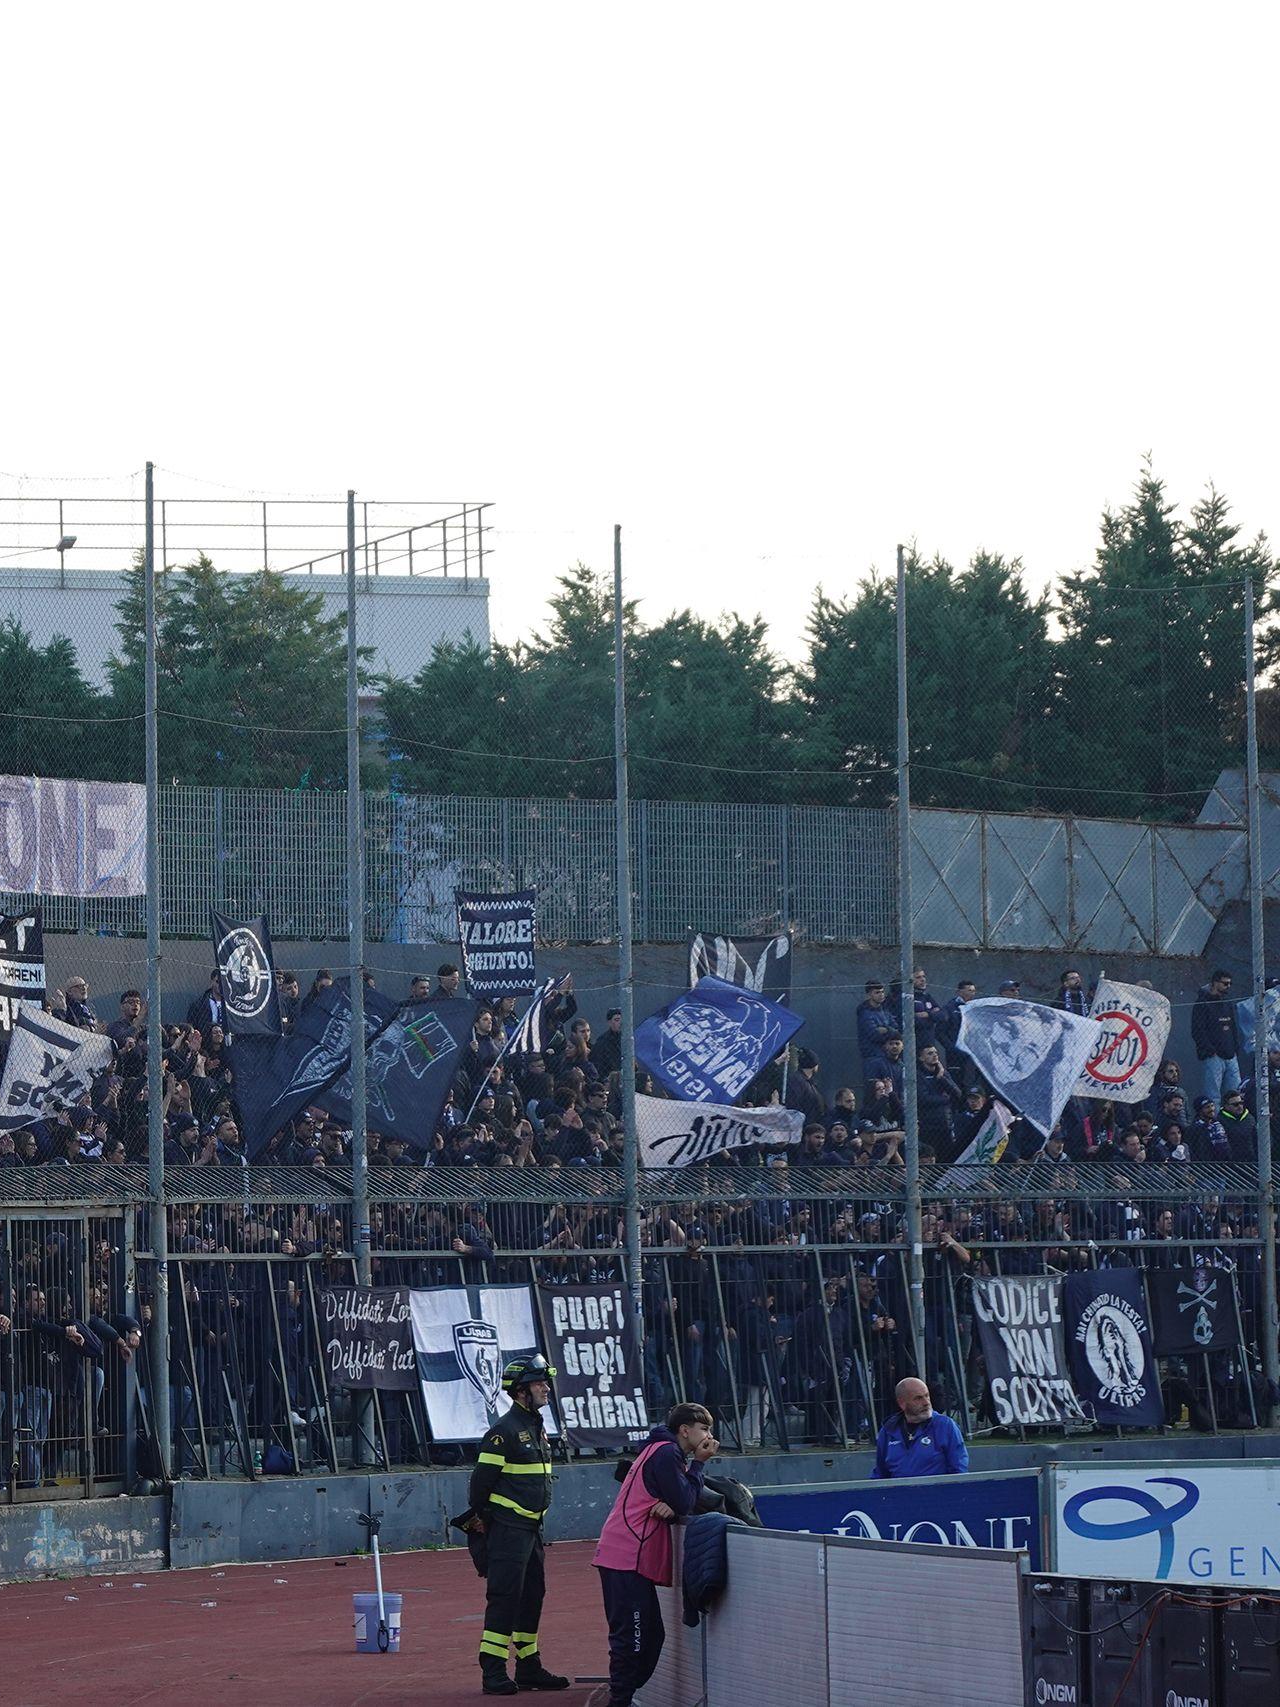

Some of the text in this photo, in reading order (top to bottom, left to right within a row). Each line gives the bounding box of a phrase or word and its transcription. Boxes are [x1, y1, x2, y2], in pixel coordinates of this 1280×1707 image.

[1095, 1000, 1153, 1027] VIETATO
[1080, 1069, 1136, 1092] VIETARE
[552, 1289, 625, 1337] fuori
[972, 1277, 1062, 1326] CODICE
[1081, 1293, 1110, 1322] CHINATO
[1110, 1294, 1121, 1309] LA
[1075, 1321, 1089, 1343] MAI
[563, 1335, 626, 1392] dagli
[999, 1326, 1058, 1377] NON
[561, 1387, 649, 1429] schemi
[1098, 1384, 1147, 1408] ULTRAS
[1188, 1546, 1280, 1578] GEN
